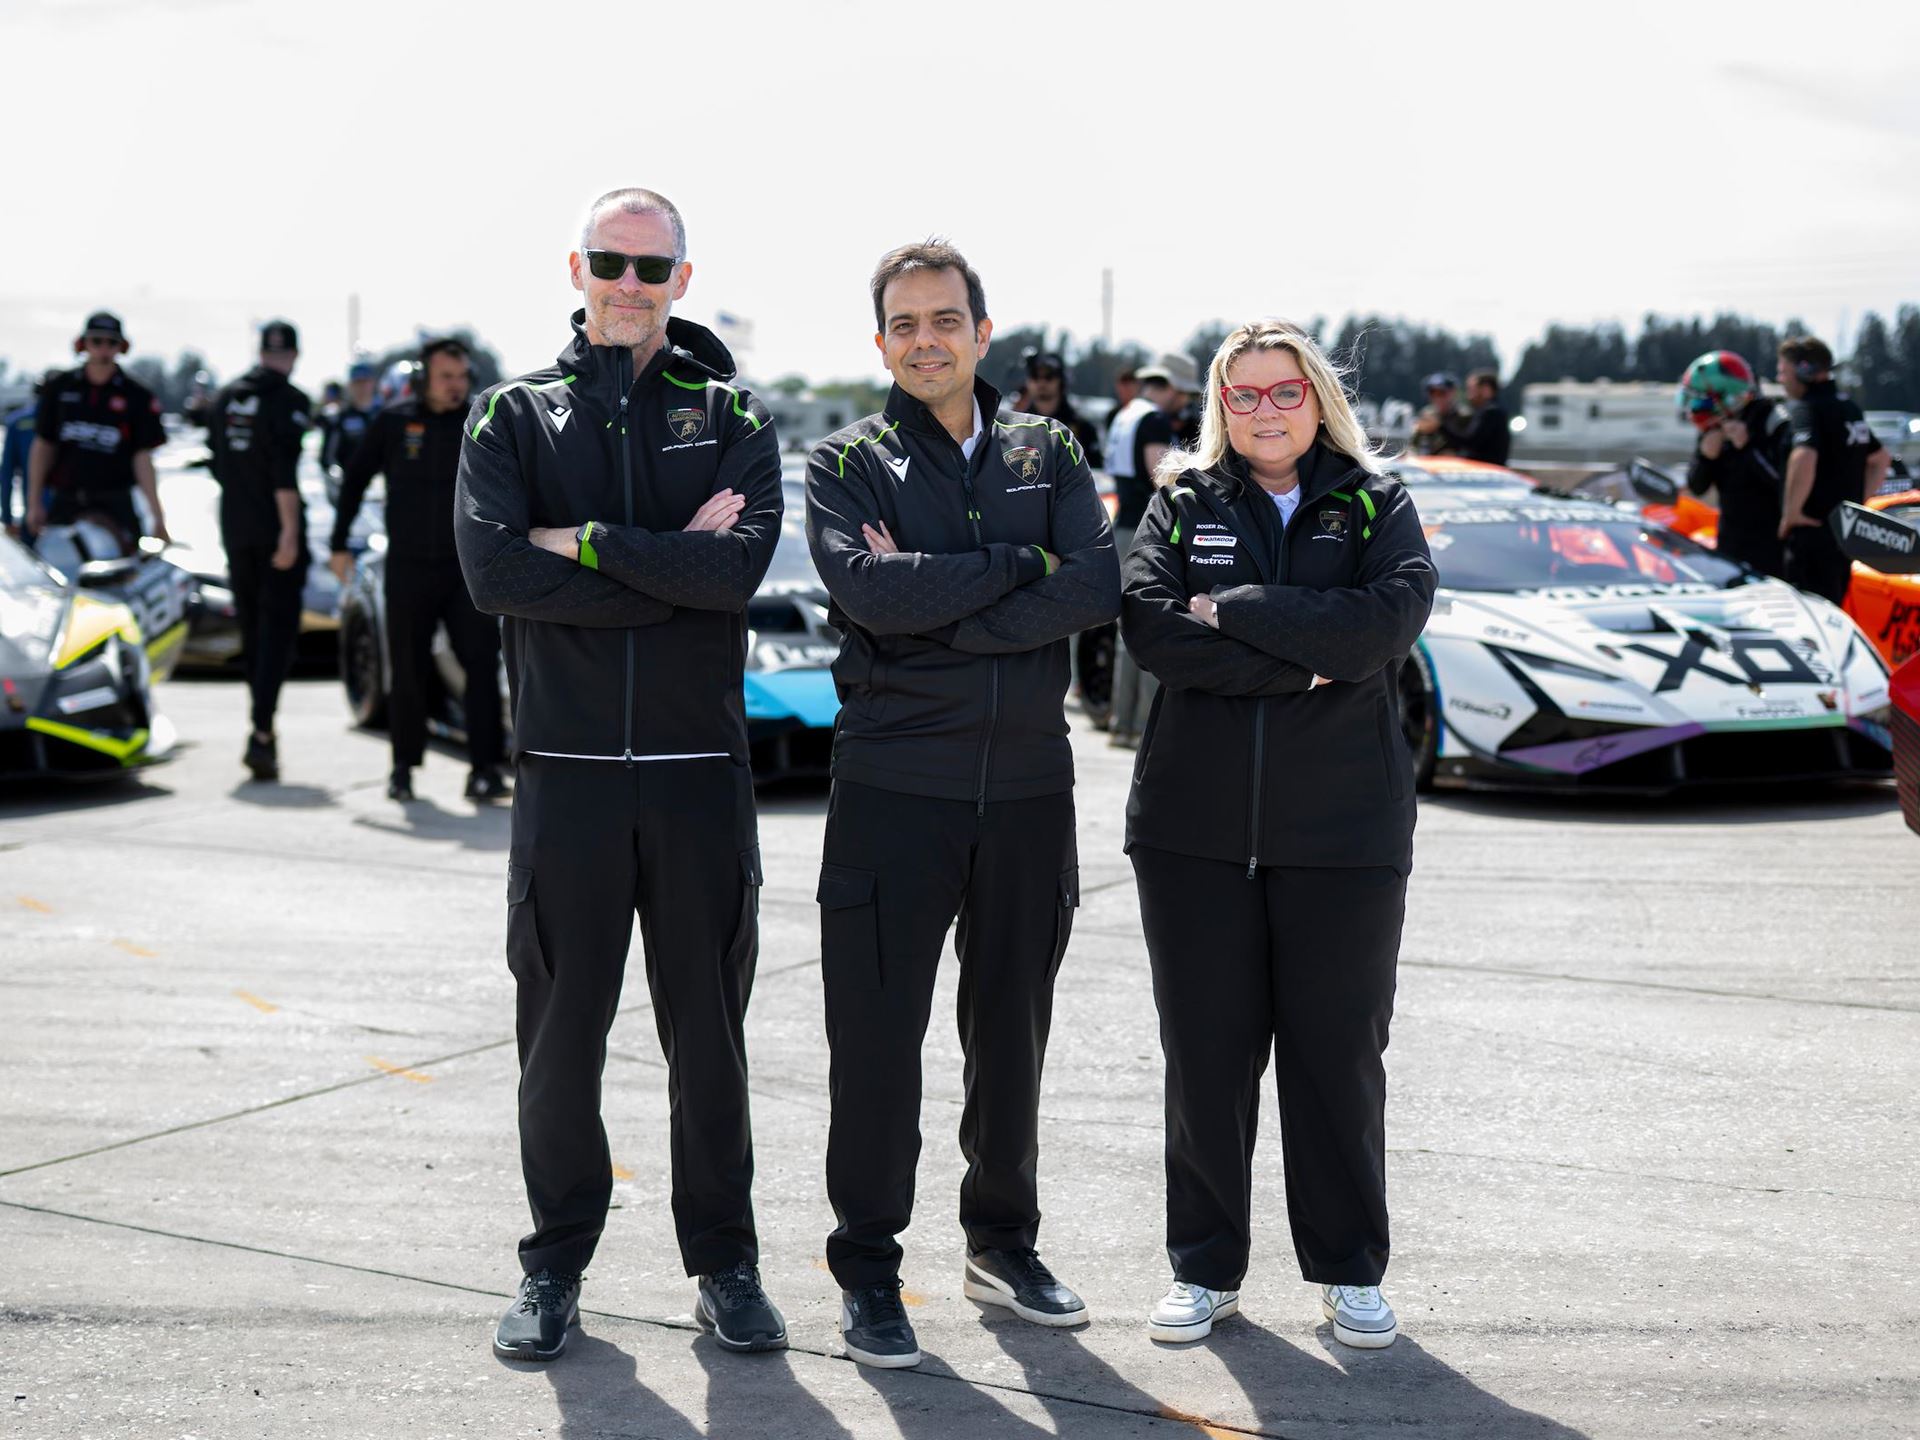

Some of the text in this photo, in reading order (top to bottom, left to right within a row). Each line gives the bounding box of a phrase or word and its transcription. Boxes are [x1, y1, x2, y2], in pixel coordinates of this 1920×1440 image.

[1855, 520, 1911, 552] macron
[1190, 555, 1234, 565] Fastron
[1622, 638, 1823, 695] XO
